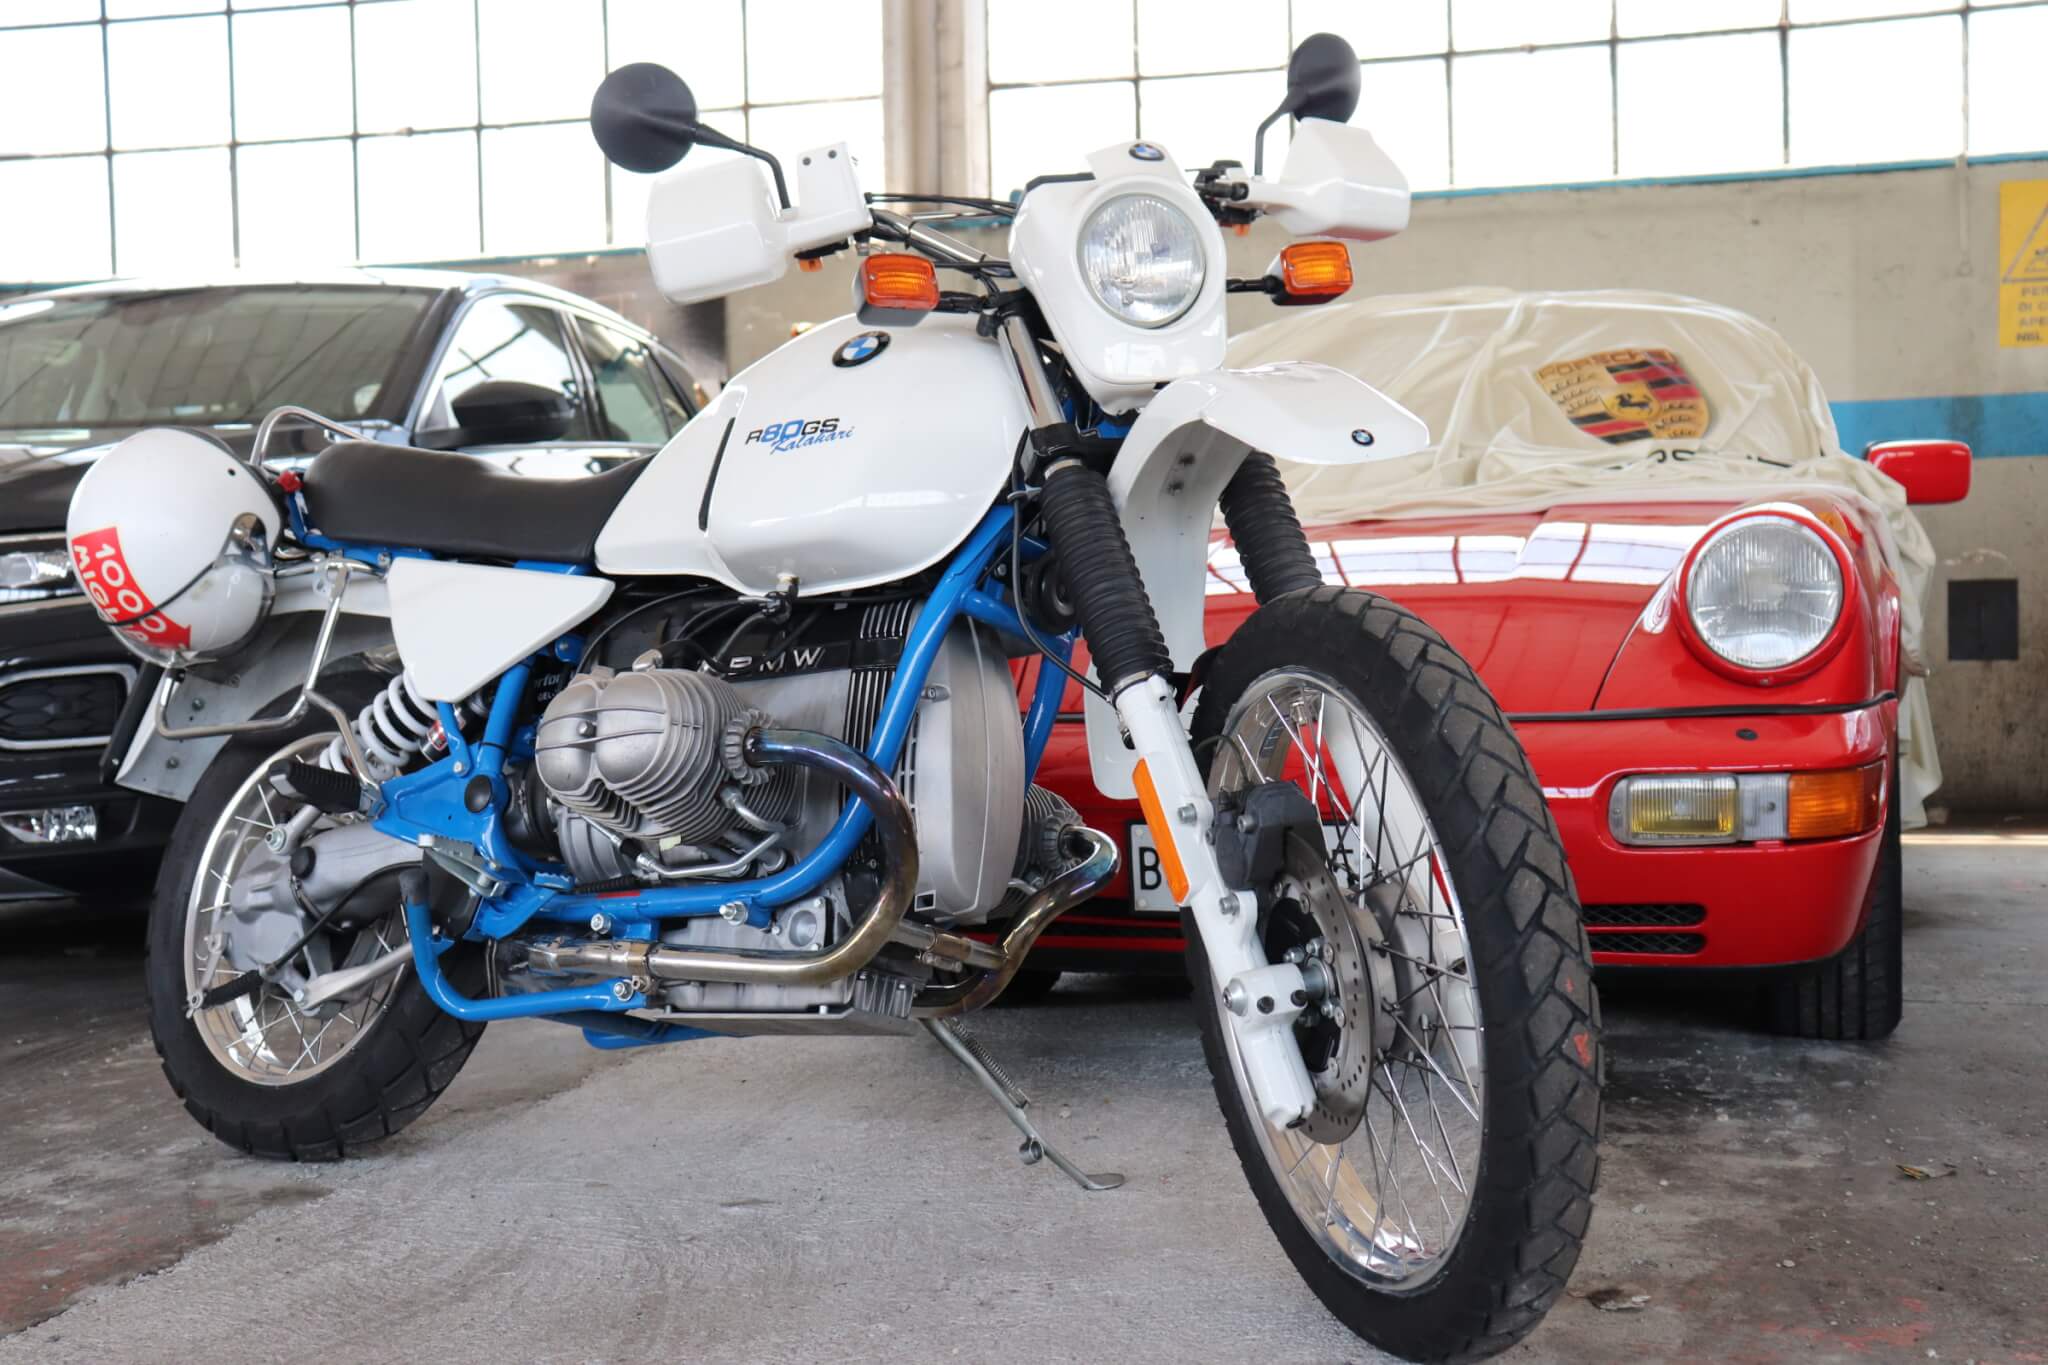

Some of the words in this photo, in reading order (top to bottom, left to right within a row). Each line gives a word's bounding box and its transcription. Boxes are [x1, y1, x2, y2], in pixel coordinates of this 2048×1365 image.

[769, 425, 856, 456] Kalahari
[74, 544, 149, 642] MIGLA
[95, 543, 167, 633] 1000
